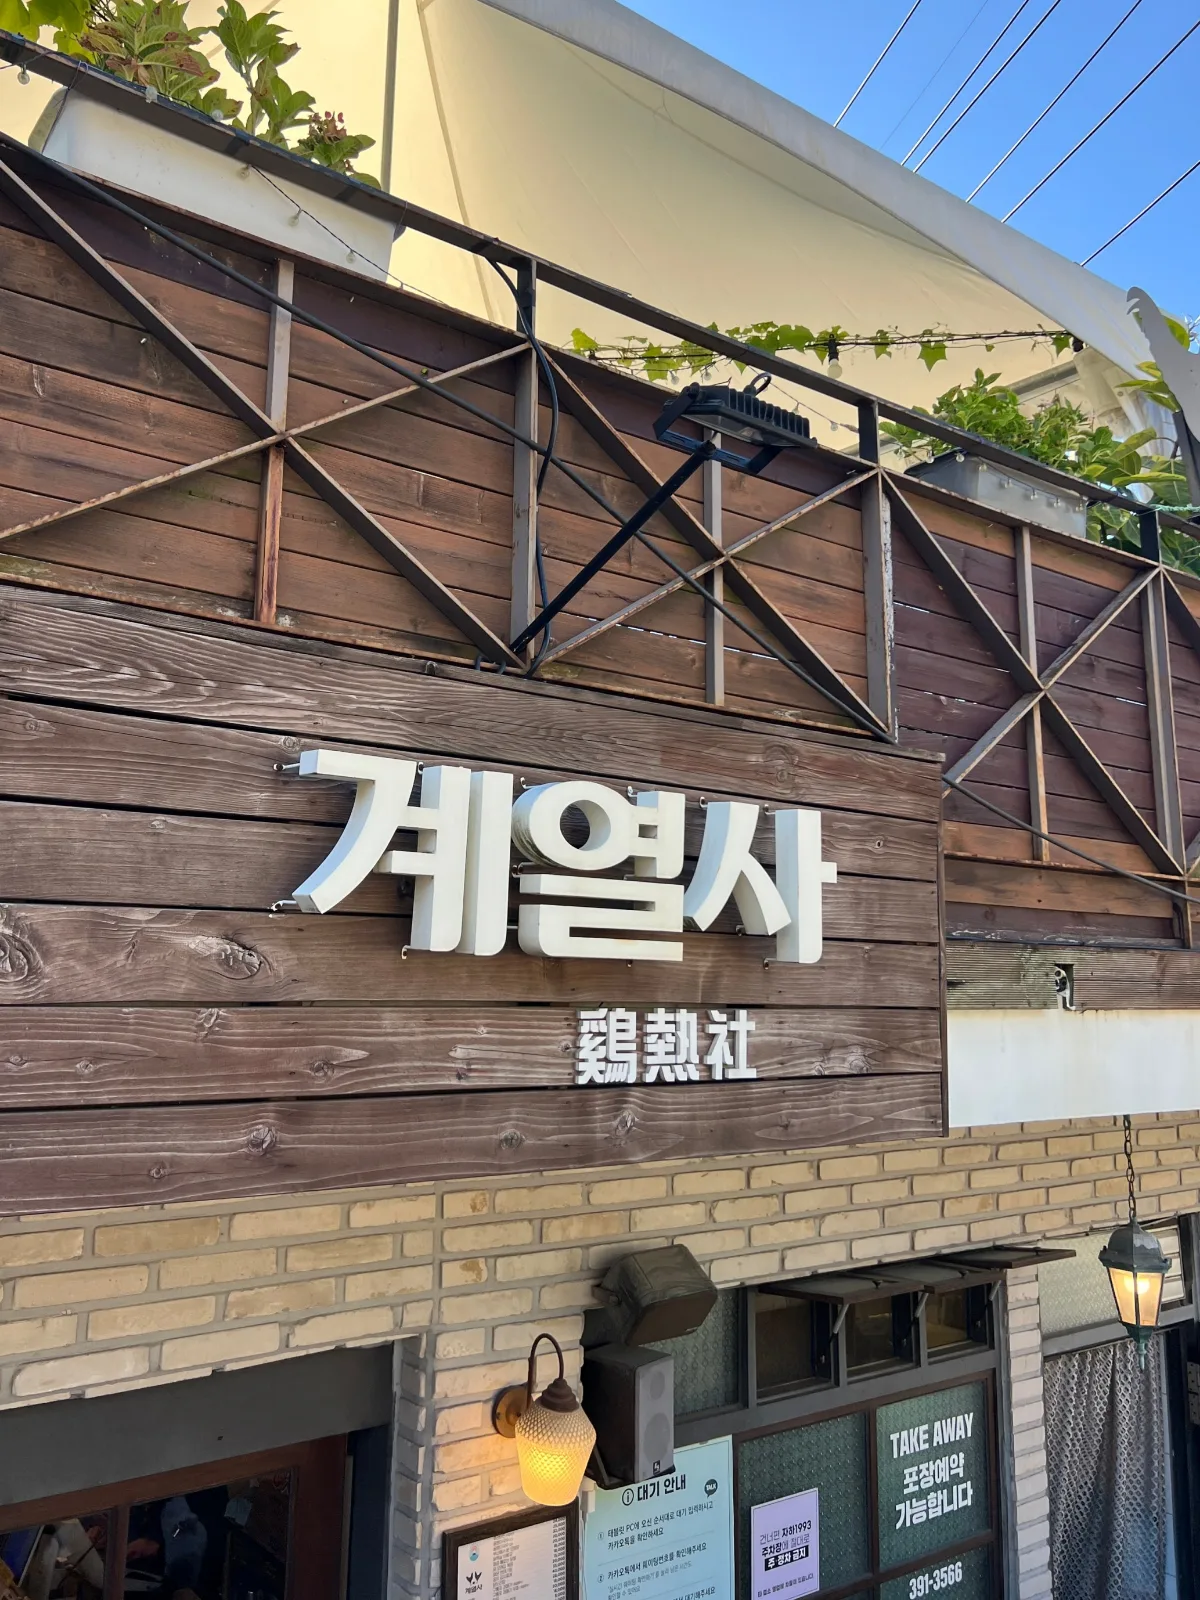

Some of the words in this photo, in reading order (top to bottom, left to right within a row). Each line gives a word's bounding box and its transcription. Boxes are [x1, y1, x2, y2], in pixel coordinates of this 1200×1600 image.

[292, 749, 837, 964] 계열사
[889, 1424, 930, 1459] TAKE
[932, 1412, 974, 1447] AWAY
[705, 1483, 717, 1491] TALK
[903, 1452, 965, 1495] 포장예약
[637, 1480, 660, 1502] 대기
[663, 1474, 686, 1494] 안내
[895, 1481, 974, 1530] 가능합니다
[607, 1525, 625, 1538] 태블릿
[625, 1521, 640, 1532] PC에
[641, 1517, 652, 1528] 오신
[653, 1511, 675, 1525] 순서대로
[675, 1508, 687, 1518] 대기
[760, 1530, 780, 1545] 건너편
[781, 1519, 812, 1538] 자하1993
[607, 1534, 635, 1550] 카카오톡을
[637, 1527, 664, 1541] 확인하세요
[761, 1540, 789, 1557] 주차장에
[790, 1533, 810, 1548] 절대로
[792, 1547, 806, 1561] 금지
[607, 1562, 641, 1580] 카카오톡에서
[908, 1561, 963, 1600] 391-3566
